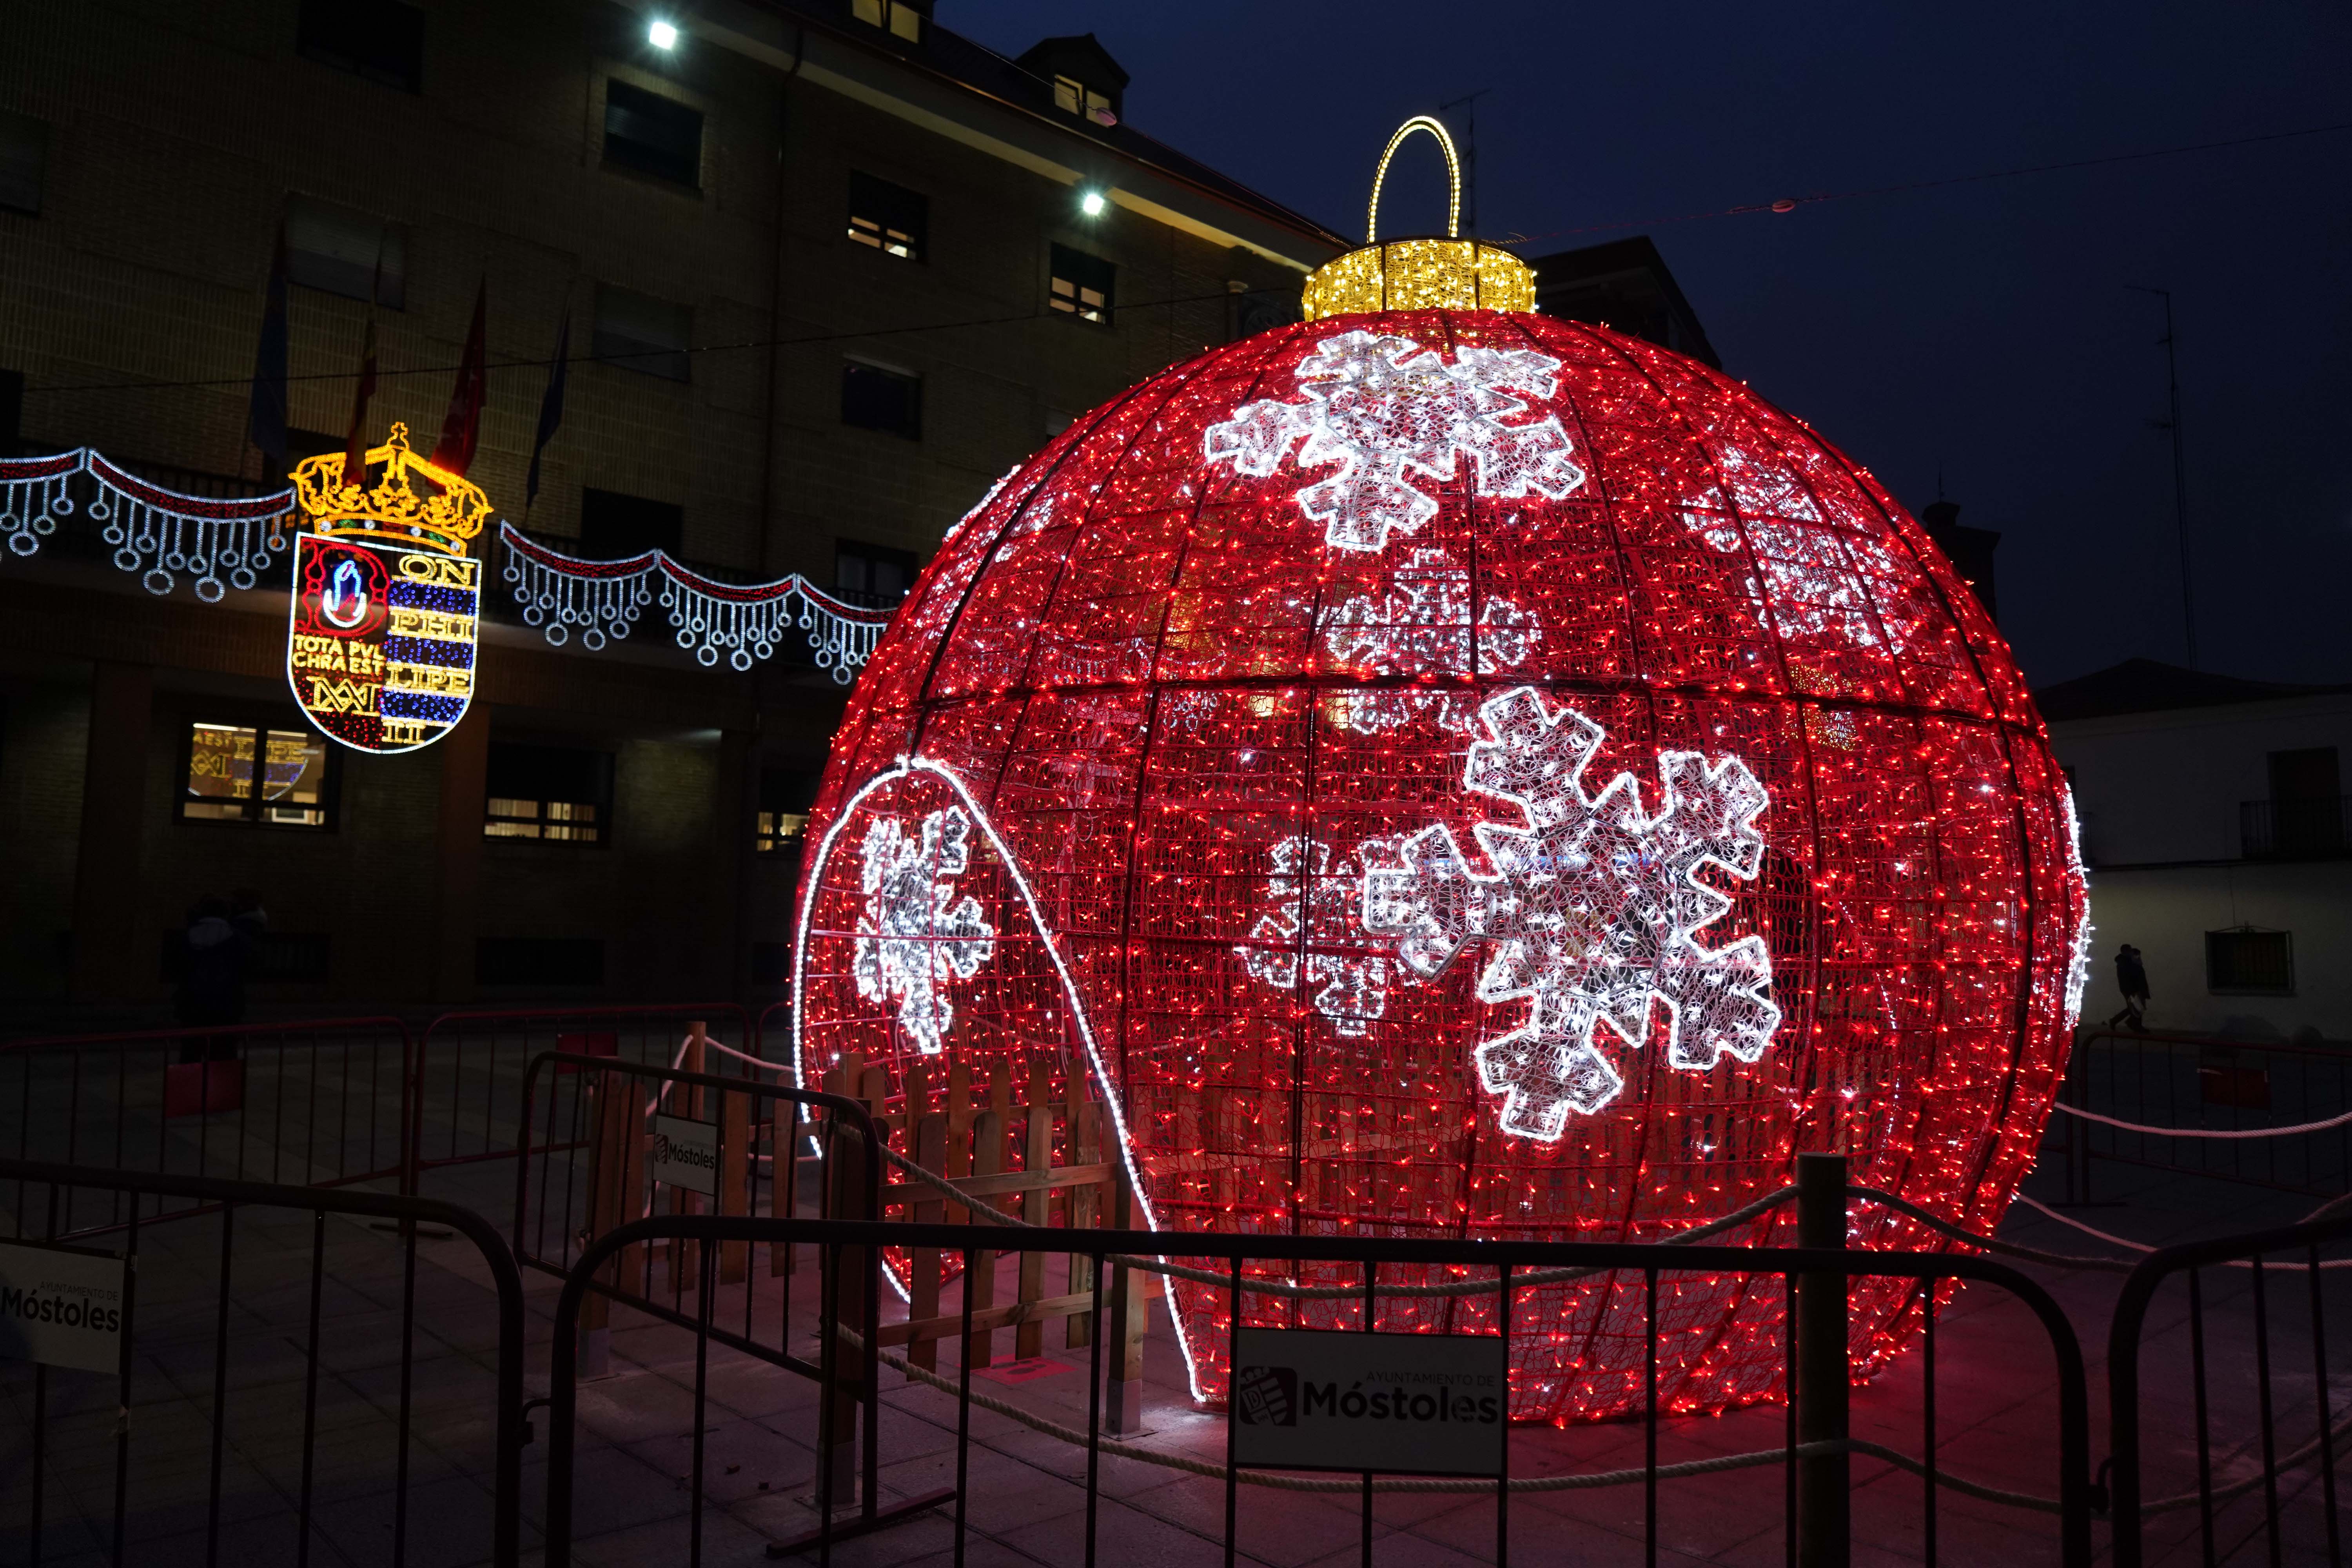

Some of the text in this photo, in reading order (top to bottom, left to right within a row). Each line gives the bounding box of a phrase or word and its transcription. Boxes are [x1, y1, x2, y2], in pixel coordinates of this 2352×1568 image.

[399, 555, 475, 585] ON
[390, 611, 472, 638] PHI
[295, 634, 385, 660] TOTA PVL
[292, 652, 385, 676] CHRA EST
[386, 666, 470, 694] LIPE
[381, 722, 426, 745] II
[669, 1143, 714, 1169] Móstoles
[40, 1281, 118, 1301] AYUNTAMIENTO DE
[2, 1287, 119, 1332] Móstoles
[1366, 1371, 1495, 1387] AYUNTAMIENTO DE
[1303, 1381, 1498, 1424] Móstoles
